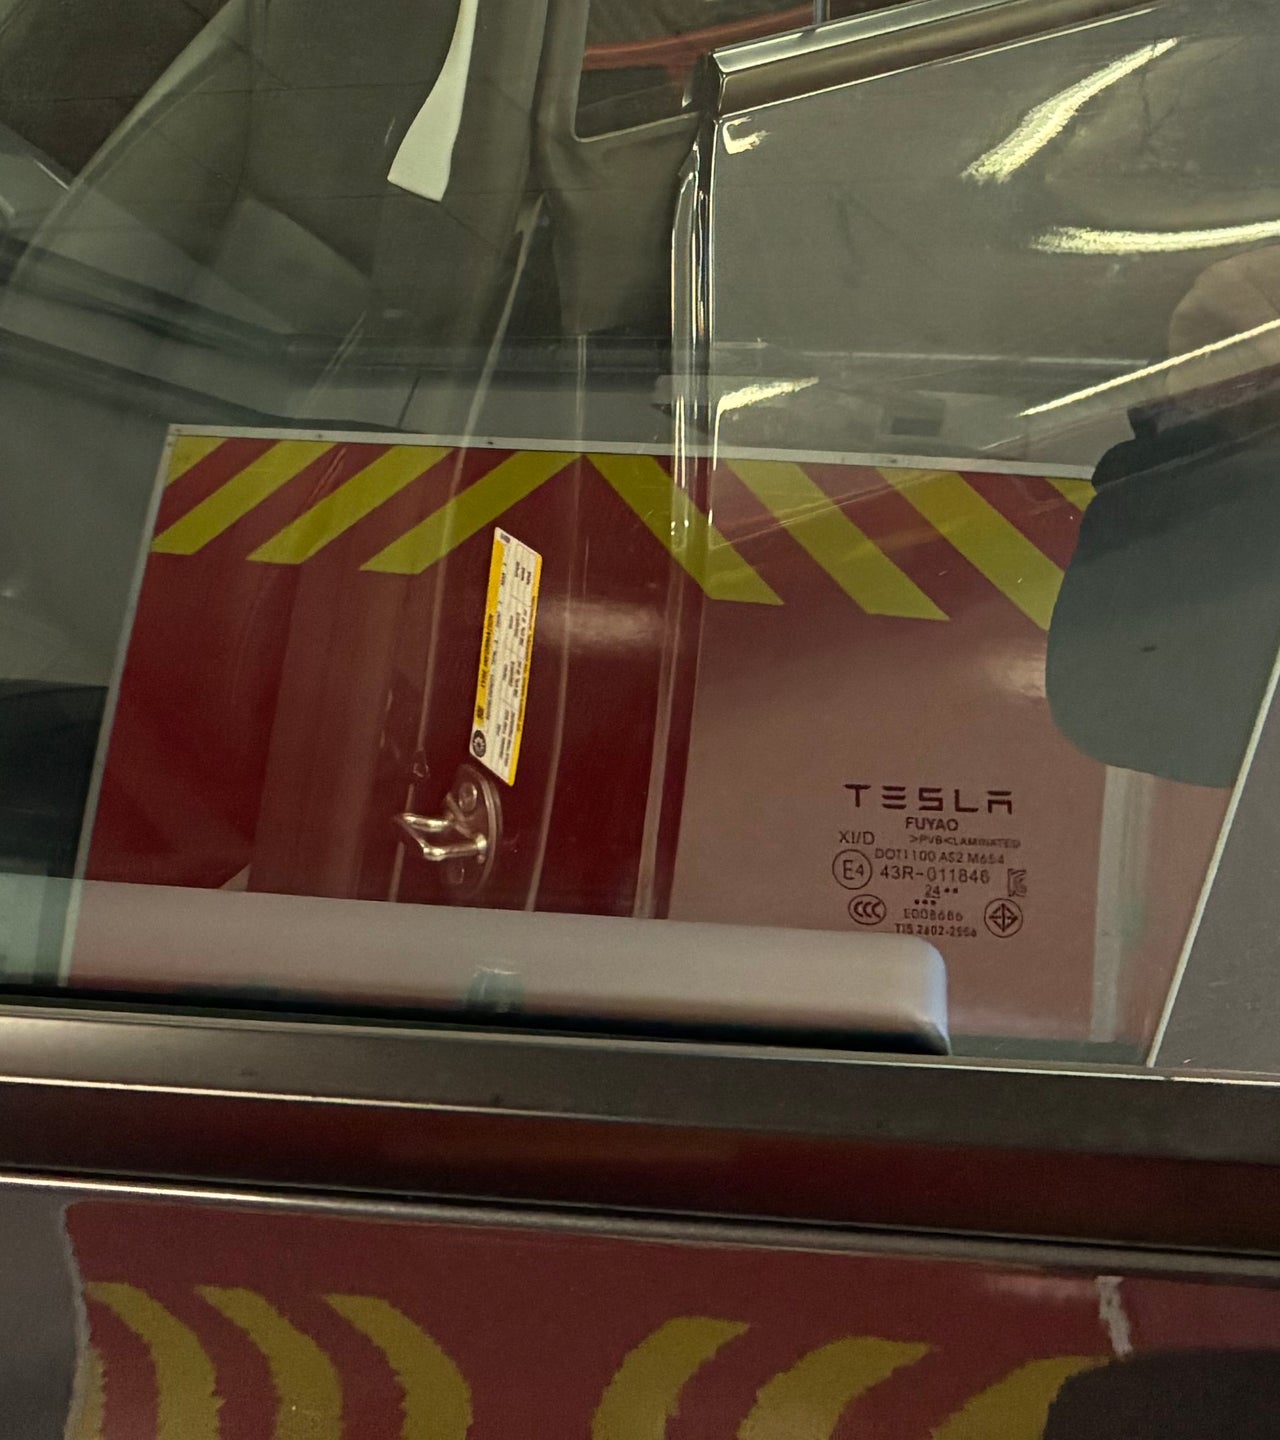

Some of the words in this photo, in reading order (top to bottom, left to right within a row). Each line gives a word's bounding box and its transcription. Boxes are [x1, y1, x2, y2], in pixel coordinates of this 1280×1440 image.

[844, 783, 1013, 815] TESLA
[905, 816, 959, 832] FUYAO
[843, 859, 864, 880] E4
[880, 864, 991, 885] 43R-011846
